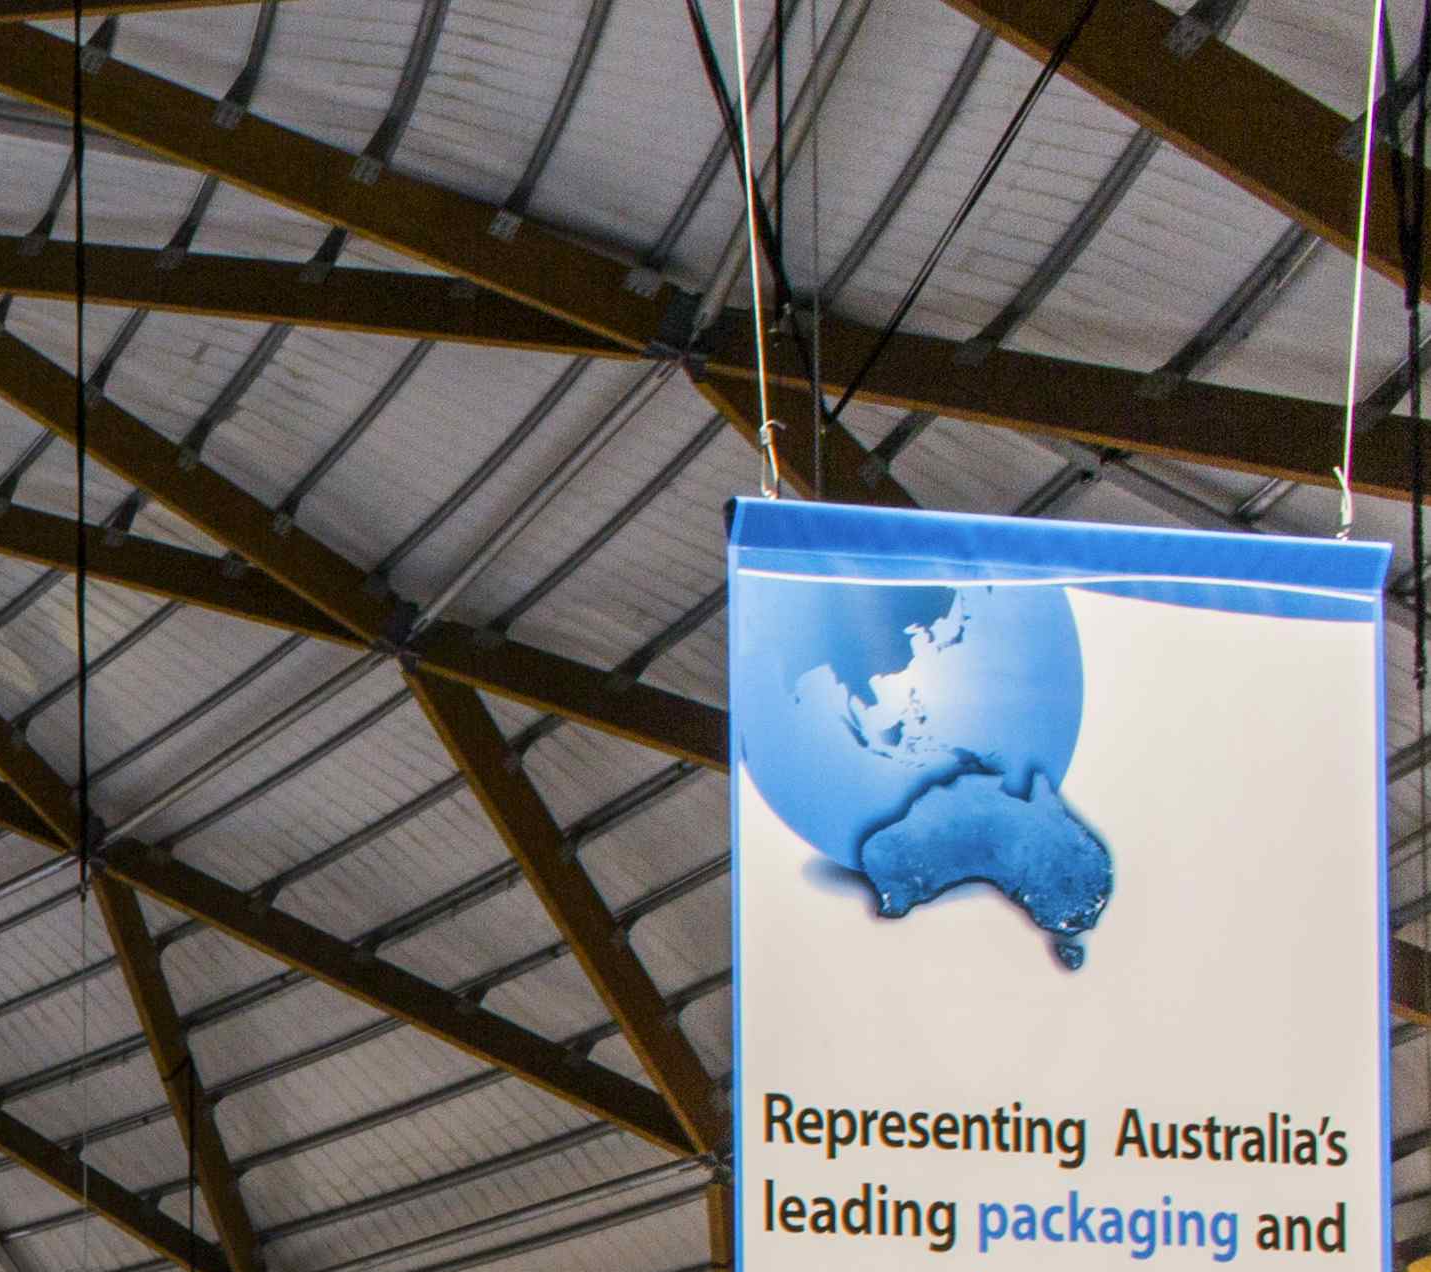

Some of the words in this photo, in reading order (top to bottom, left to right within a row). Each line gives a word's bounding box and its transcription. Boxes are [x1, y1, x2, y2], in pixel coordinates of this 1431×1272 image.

[764, 1093, 1087, 1169] Representing
[1116, 1108, 1348, 1167] Australia's
[764, 1180, 957, 1253] leading
[978, 1191, 1239, 1261] packaging
[1257, 1202, 1346, 1253] and
